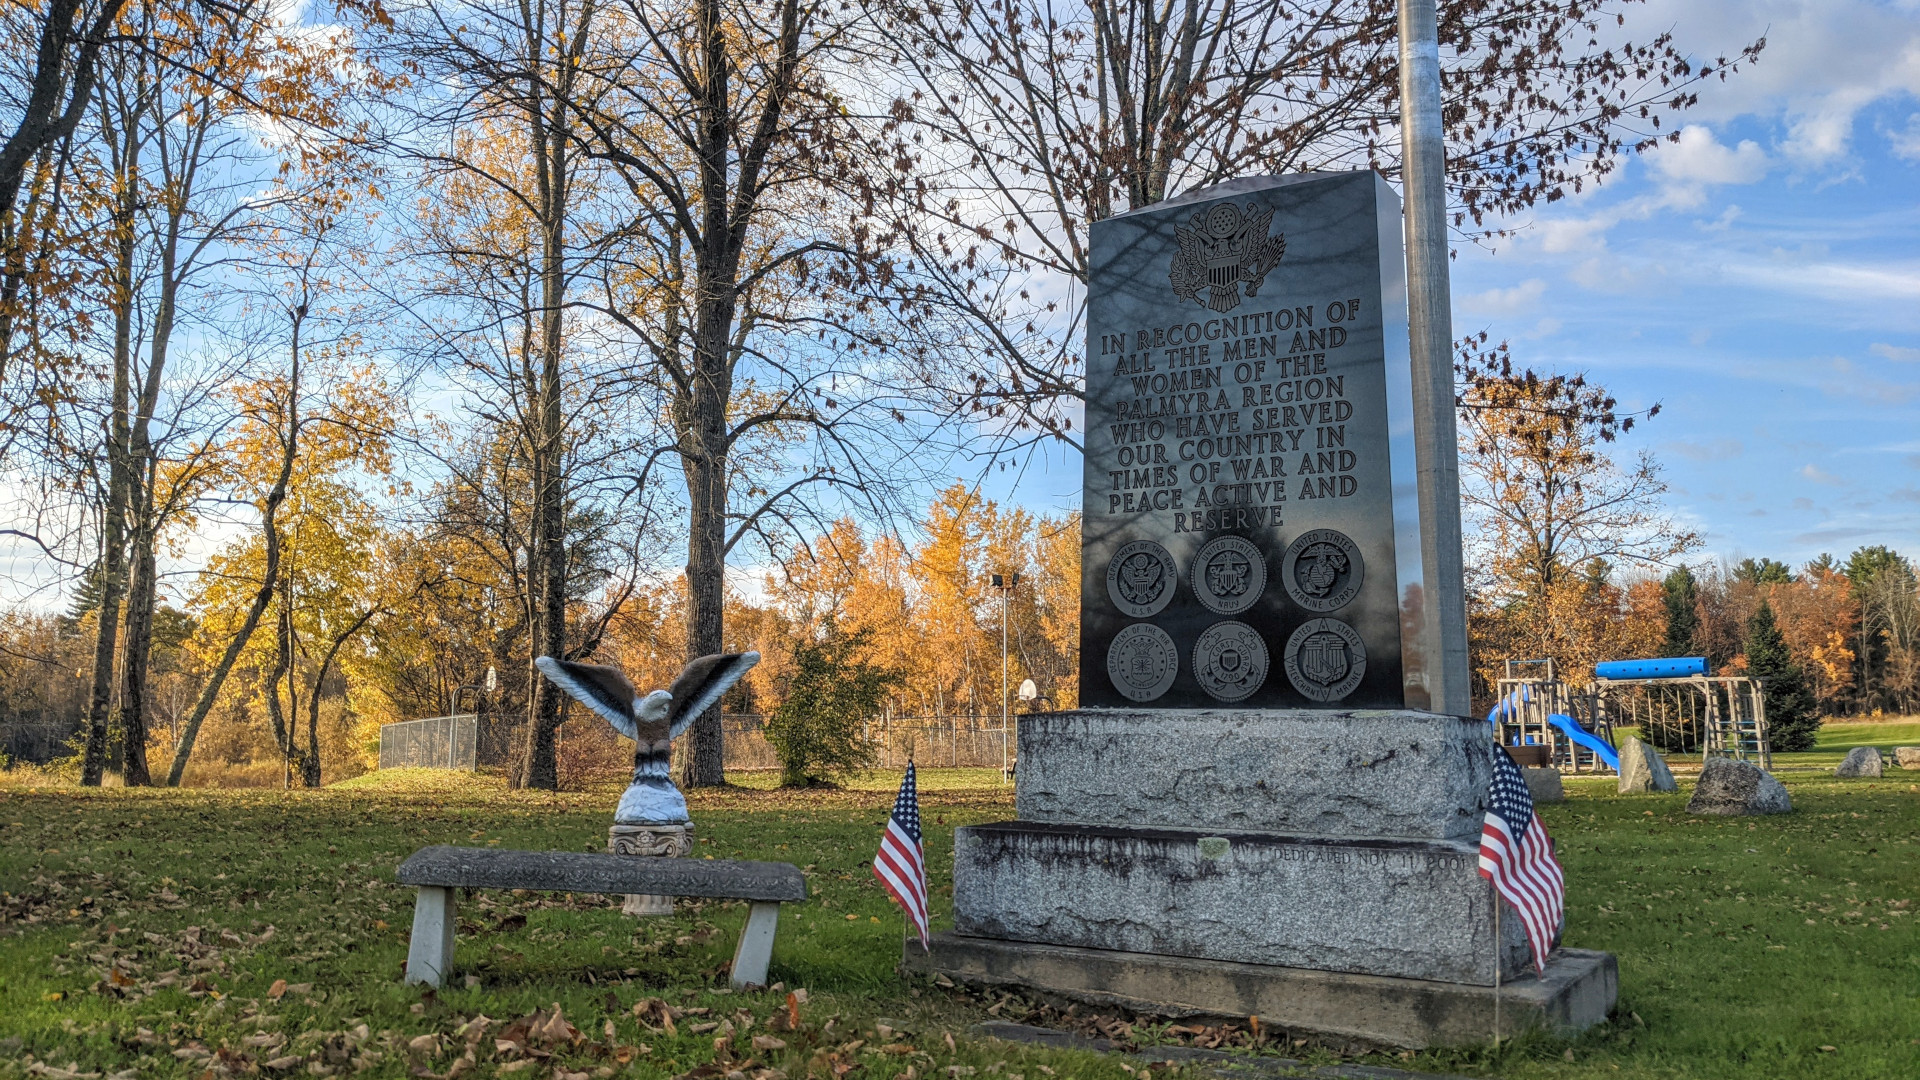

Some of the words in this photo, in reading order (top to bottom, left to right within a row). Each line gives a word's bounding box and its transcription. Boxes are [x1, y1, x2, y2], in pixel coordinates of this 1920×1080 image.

[1101, 333, 1125, 355] IN
[1137, 305, 1313, 350] RECOGNITION
[1327, 299, 1360, 323] OF
[1114, 354, 1155, 376] ALL
[1165, 344, 1210, 369] THE
[1223, 335, 1277, 362] MEN
[1289, 326, 1347, 354] AND
[1131, 366, 1221, 397] WOMEN
[1234, 361, 1265, 383] OF
[1276, 353, 1327, 379] THE
[1117, 388, 1230, 421] PALMYRA
[1242, 376, 1344, 408] REGION
[1110, 420, 1164, 445] WHO
[1176, 412, 1241, 438] HAVE
[1253, 400, 1353, 431] SERVED
[1118, 444, 1169, 467] OUR
[1179, 429, 1304, 461] COUNTRY
[1317, 425, 1345, 449] IN
[1109, 465, 1178, 491] TIMES
[1190, 462, 1220, 484] OF
[1231, 456, 1287, 480] WAR
[1298, 450, 1357, 476] AND
[1109, 489, 1183, 514] PEACE
[1195, 480, 1286, 508] ACTIVE
[1299, 475, 1357, 500] AND
[1174, 505, 1283, 533] RESERVE
[1201, 542, 1225, 561] UNITED
[1231, 541, 1255, 559] STATES
[1291, 533, 1319, 554] UNITED
[1324, 532, 1352, 552] STATES
[1109, 544, 1136, 580] DEPARTMENT
[1139, 543, 1148, 551] OF
[1152, 545, 1163, 557] THE
[1163, 557, 1175, 578] ARMY
[1218, 600, 1239, 609] NAVY
[1291, 589, 1322, 609] MARINE
[1328, 587, 1354, 607] CORPS
[1109, 631, 1129, 673] DEPARTMENT
[1131, 626, 1140, 634] OF
[1145, 626, 1156, 636] THE
[1159, 633, 1170, 646] AIR
[1167, 648, 1176, 672] FORCE
[1290, 625, 1311, 647] UNITED
[1336, 624, 1359, 647] STATES
[1212, 641, 1234, 657] COAST
[1237, 645, 1250, 671] GUARD
[1220, 672, 1240, 681] 1790
[1288, 664, 1320, 697] MERCHANT
[1336, 671, 1361, 695] MARINE
[1273, 848, 1351, 865] DEDICATED
[1426, 857, 1466, 871] 2001
